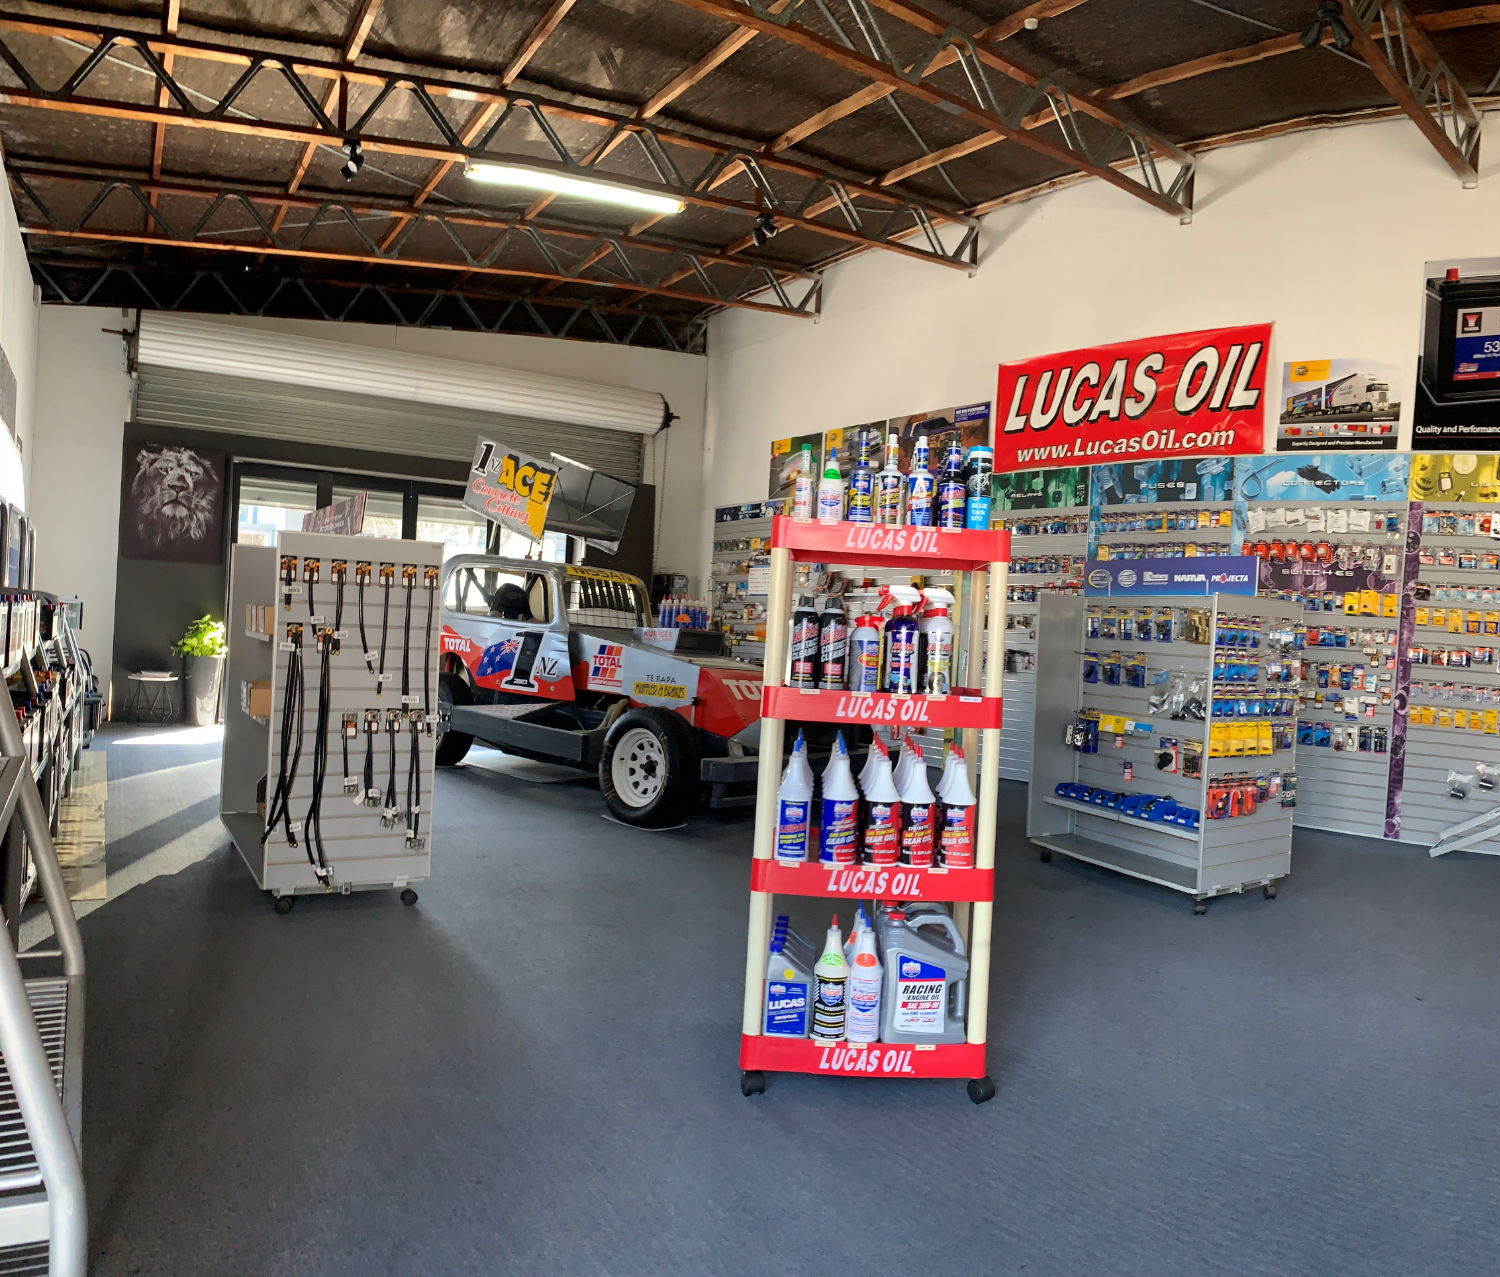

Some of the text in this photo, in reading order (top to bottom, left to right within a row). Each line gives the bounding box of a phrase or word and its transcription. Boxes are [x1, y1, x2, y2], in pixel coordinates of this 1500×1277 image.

[1003, 341, 1264, 434] LUCAS OIL
[1415, 425, 1442, 435] Quality
[1442, 425, 1457, 433] and
[1017, 429, 1236, 463] www.LucasOil.com
[473, 442, 496, 476] 1
[498, 454, 554, 505] ACE
[1139, 481, 1186, 490] FUSES
[473, 478, 521, 506] Concrete
[845, 527, 908, 550] LUCAS
[573, 565, 634, 583] NISSAN
[1173, 573, 1207, 583] NARVA
[1211, 572, 1249, 585] PROJECTA
[1281, 568, 1355, 578] SWITCHES
[444, 637, 472, 653] TOTAL
[504, 629, 560, 690] 1 NZ
[592, 655, 622, 669] TOTAL
[646, 674, 677, 685] TE RAPA
[663, 686, 686, 700] BRAKES
[836, 697, 898, 722] LUCAS
[865, 834, 895, 844] GEAR OIL
[903, 835, 932, 845] GEAR OIL
[958, 836, 970, 844] OIL
[827, 869, 888, 895] LUCAS
[902, 984, 943, 995] RACING
[768, 997, 806, 1010] LUCAS
[906, 1001, 941, 1010] SAE 20W-50
[818, 1047, 880, 1072] LUCAS
